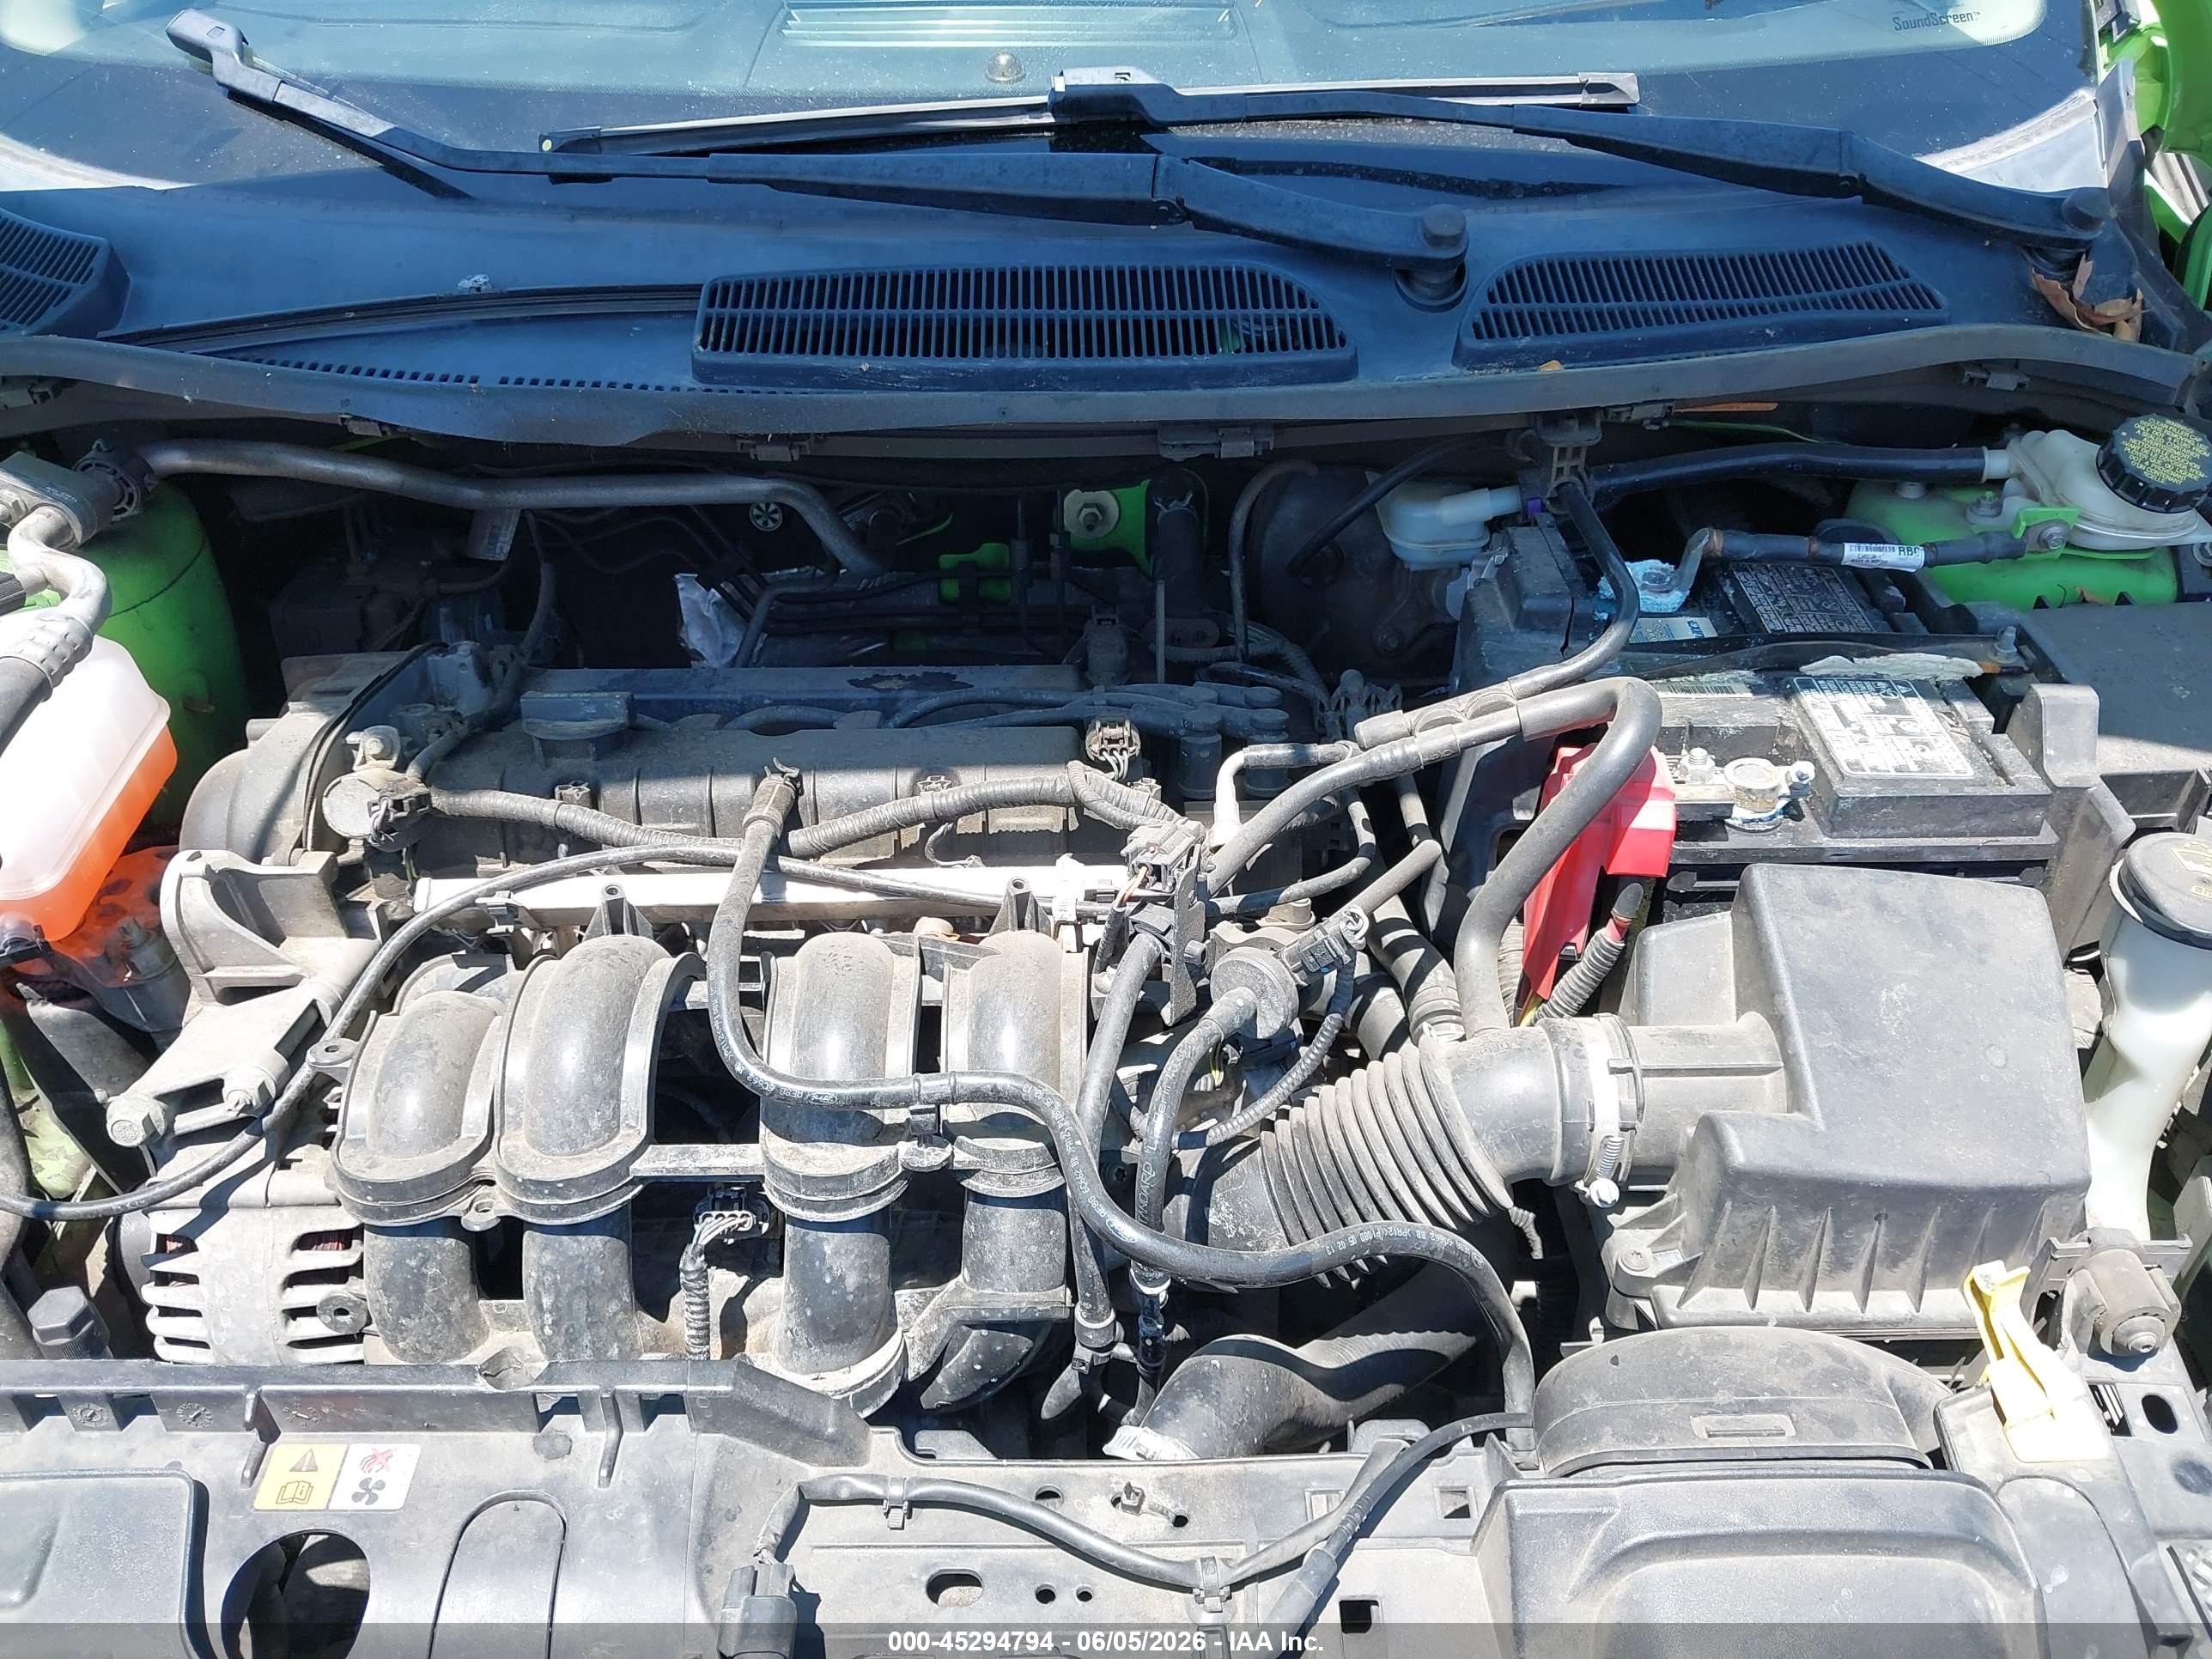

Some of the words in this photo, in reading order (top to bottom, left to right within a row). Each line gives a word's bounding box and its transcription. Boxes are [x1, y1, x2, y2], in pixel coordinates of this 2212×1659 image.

[2134, 423, 2151, 433] ONLY
[2172, 438, 2191, 449] FLUID
[2129, 454, 2142, 463] DOT
[1074, 1169, 1091, 1194] 6C662
[1139, 1161, 1157, 1224] TANDARD
